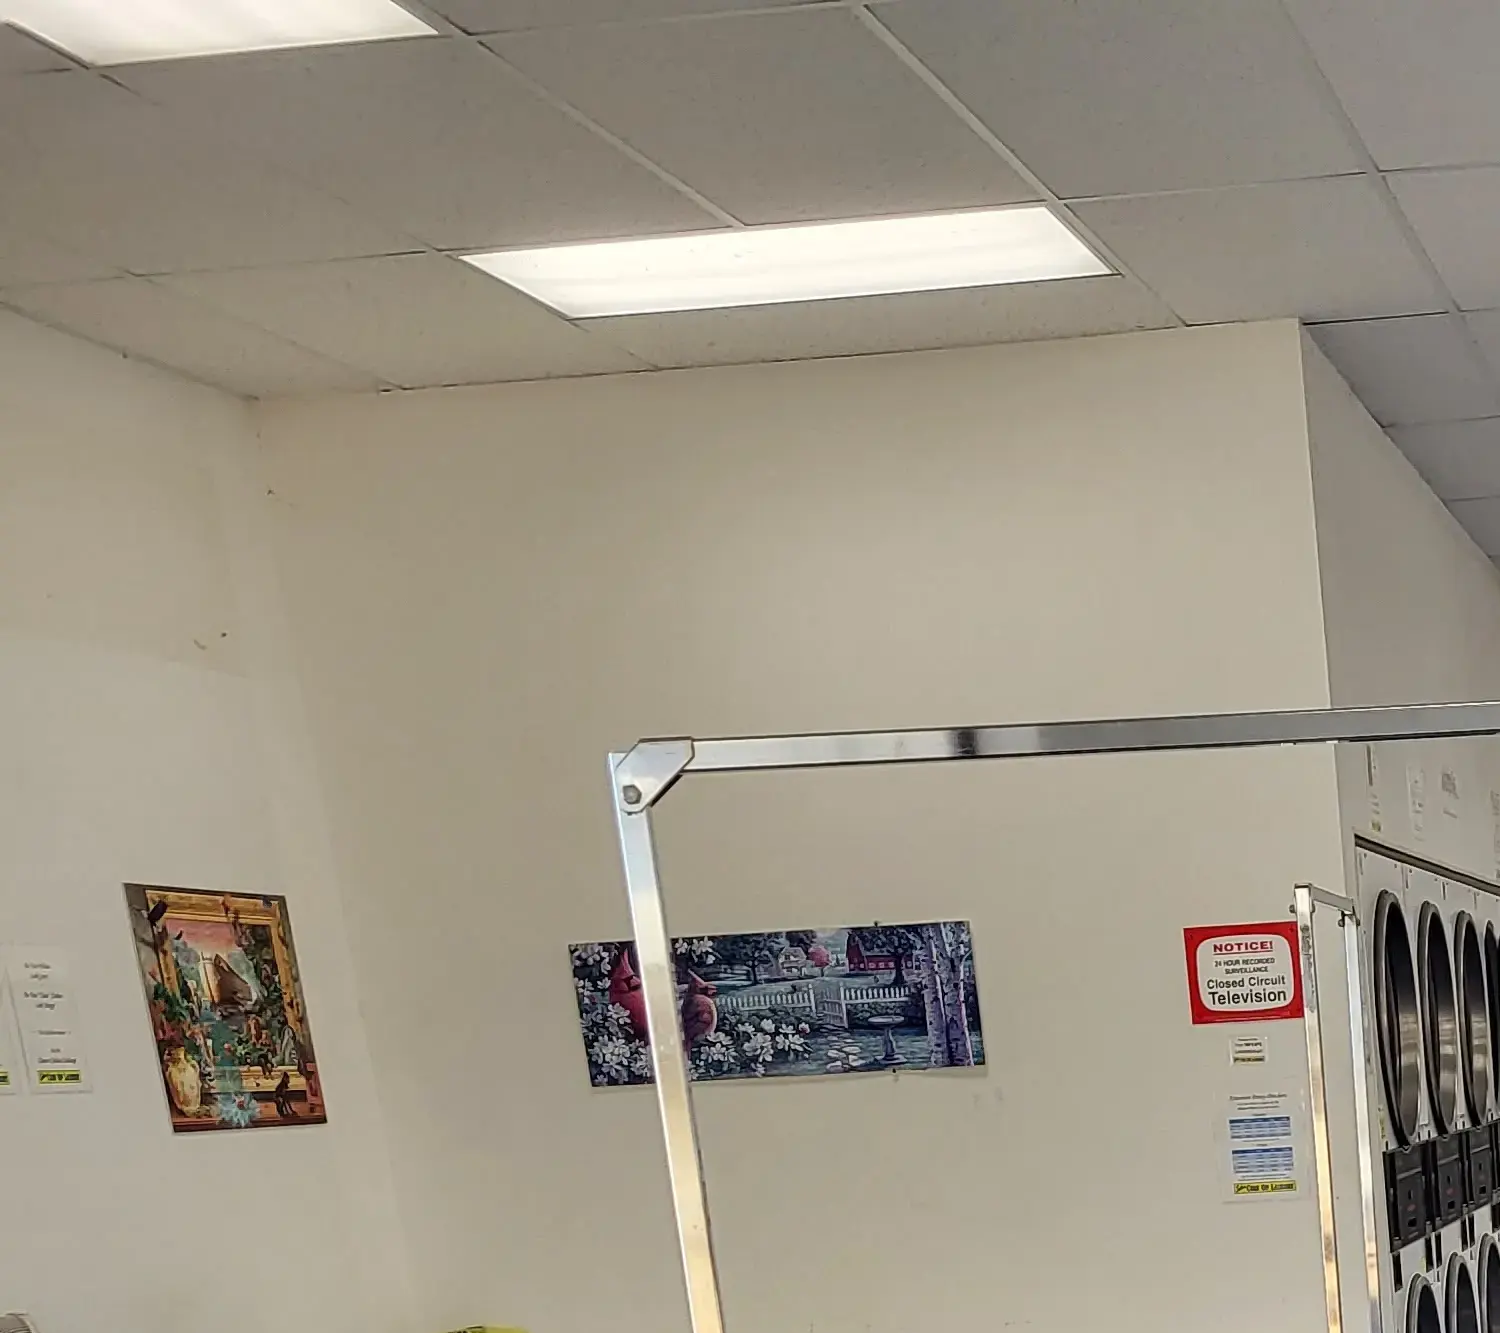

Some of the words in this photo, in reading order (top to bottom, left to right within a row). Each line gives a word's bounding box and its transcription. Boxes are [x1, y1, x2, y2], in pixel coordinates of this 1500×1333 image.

[1212, 941, 1274, 953] NOTICE!
[1206, 978, 1245, 989] Closed
[1248, 975, 1286, 987] Circuit
[1208, 988, 1287, 1006] Television
